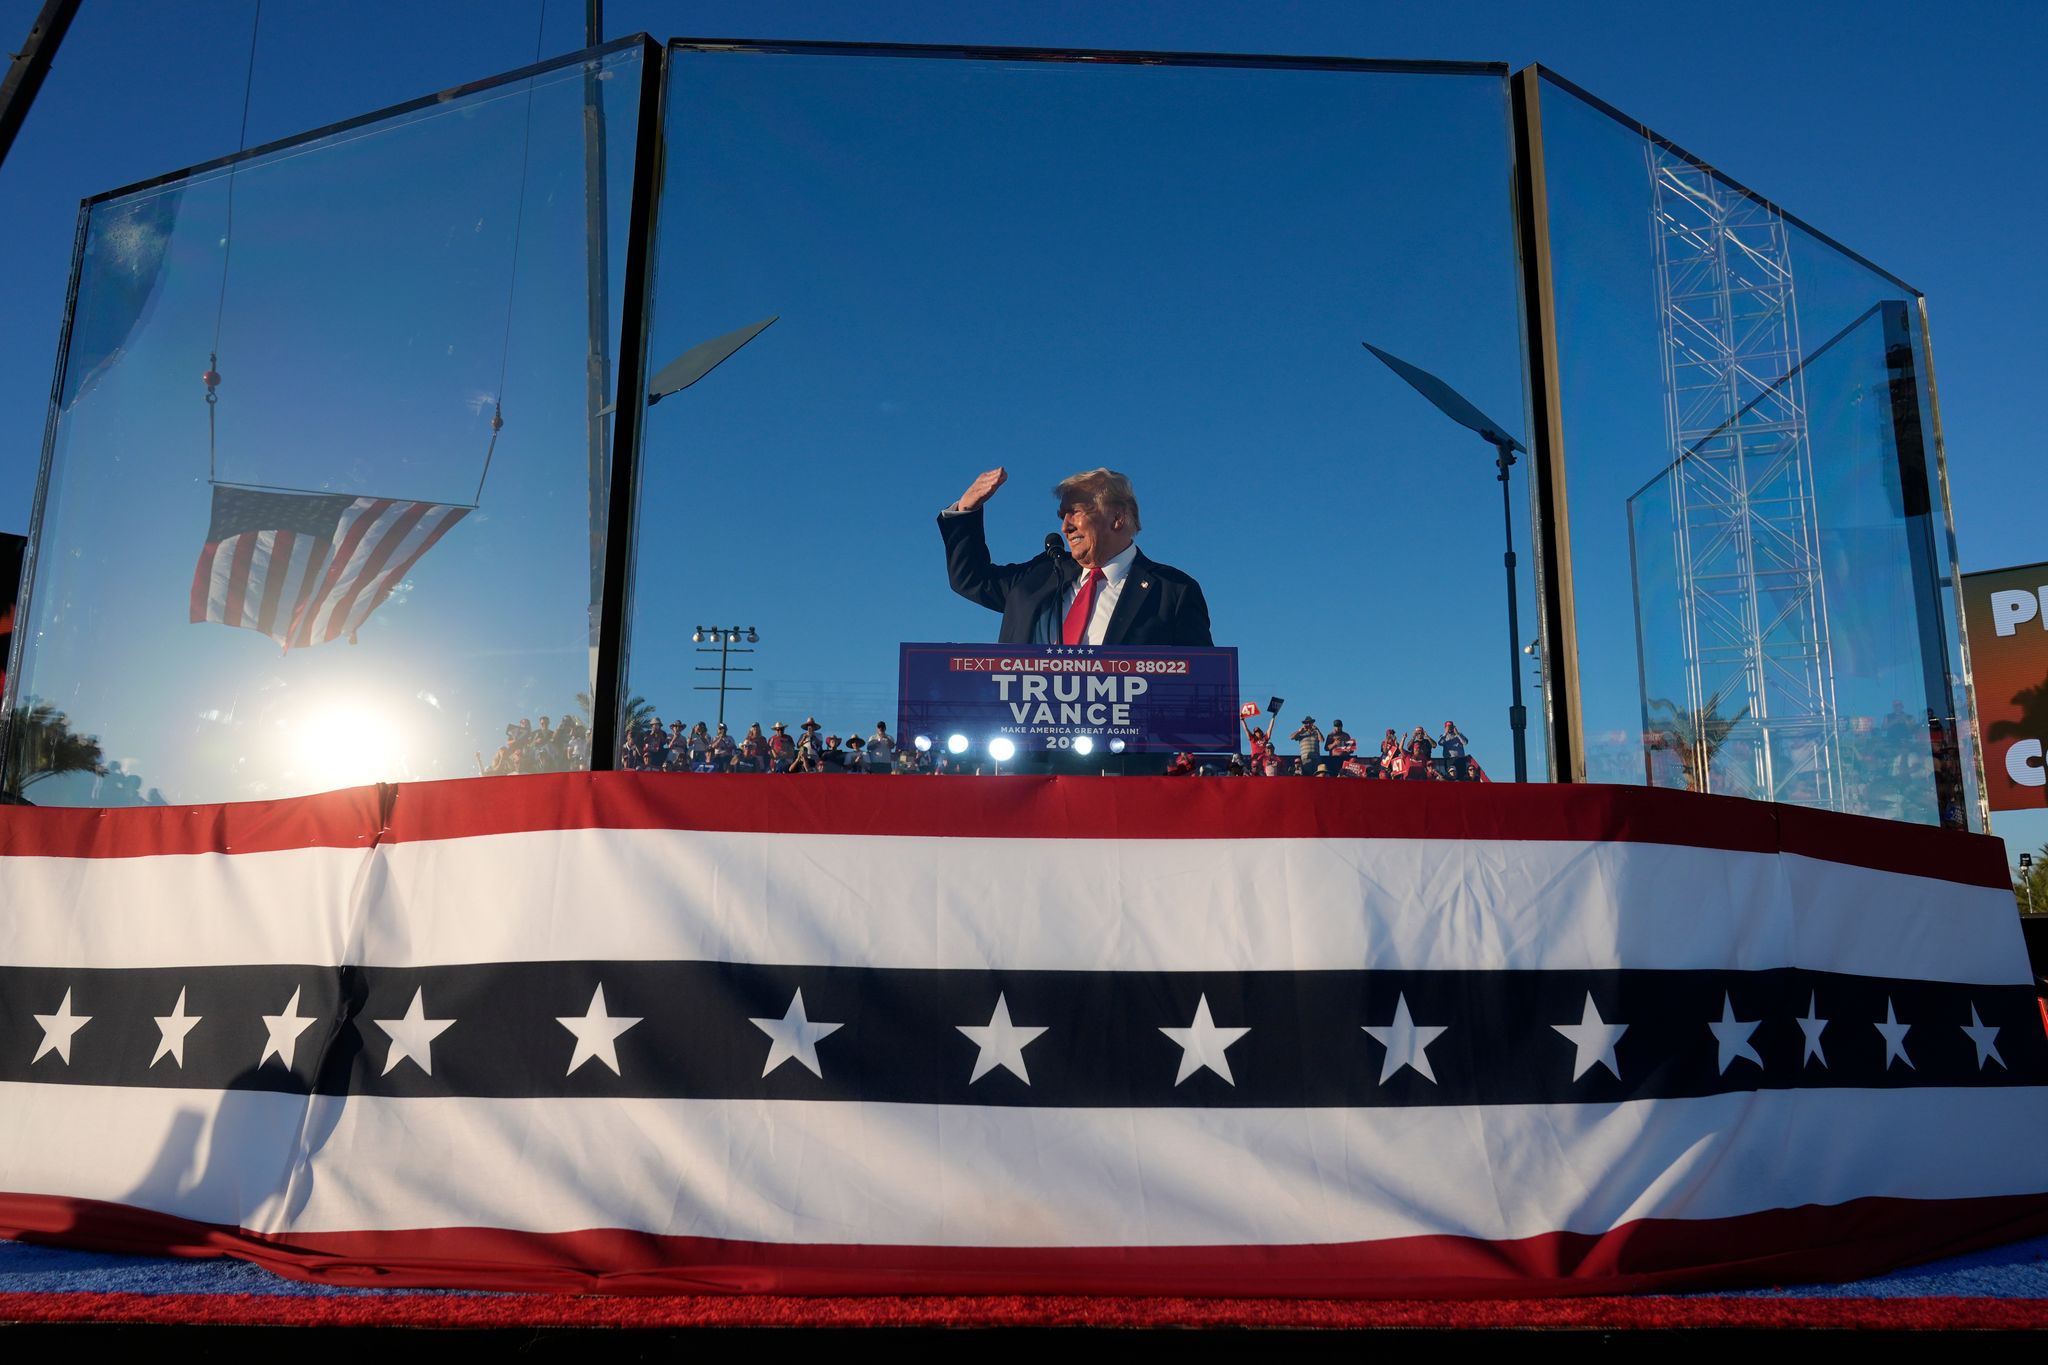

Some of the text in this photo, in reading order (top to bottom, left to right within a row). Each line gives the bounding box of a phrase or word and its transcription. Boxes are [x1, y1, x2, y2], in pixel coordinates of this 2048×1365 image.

[1990, 585, 2048, 637] P
[953, 658, 1187, 673] TEXT CALIFORNIA TO 88022
[991, 674, 1148, 703] TRUMP
[1009, 702, 1131, 725] VANCE
[1241, 704, 1256, 715] 47
[1000, 726, 1140, 735] MAKE AMERICA GREAT AGAIN!
[1392, 758, 1403, 772] 47
